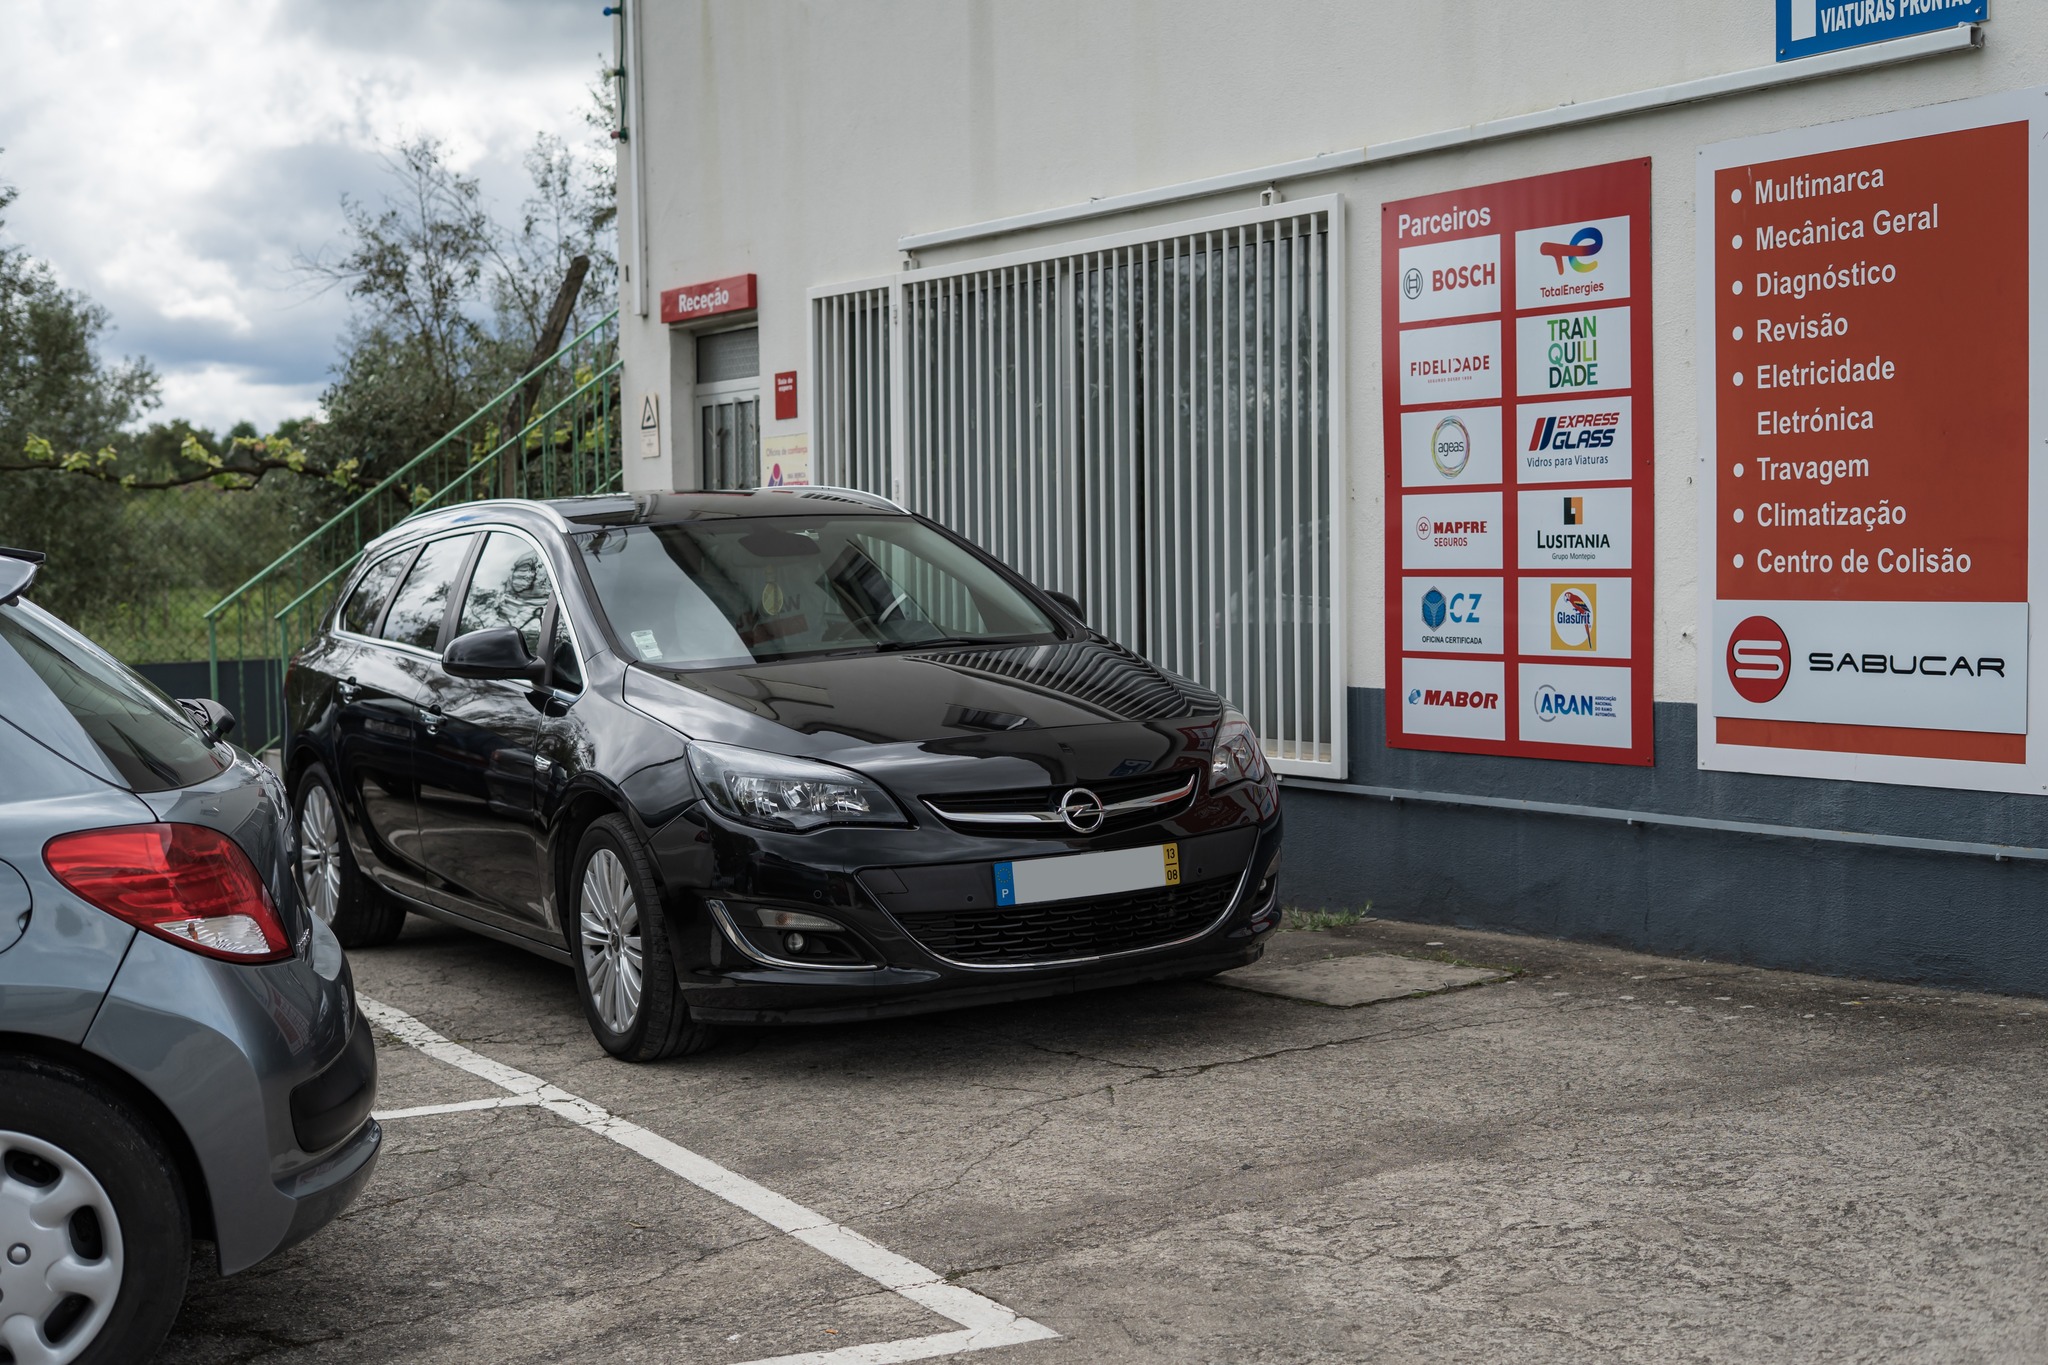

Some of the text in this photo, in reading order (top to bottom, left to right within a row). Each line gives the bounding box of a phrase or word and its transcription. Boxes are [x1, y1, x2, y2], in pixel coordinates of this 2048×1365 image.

[1820, 0, 1895, 34] VIATURAS
[1755, 167, 1884, 204] Multimarca
[1398, 206, 1491, 239] Parceiros
[1755, 203, 1938, 251] Mecânica Geral
[1432, 262, 1496, 292] BOSCH
[1540, 281, 1604, 298] TotalEnergies
[1756, 260, 1896, 300] Diagnóstico
[678, 287, 729, 313] Receção
[1547, 316, 1597, 341] TRAN
[1757, 312, 1848, 343] Revisão
[1410, 355, 1490, 376] FIDELIDADE
[1548, 340, 1597, 367] QUILI
[1549, 363, 1598, 388] DADE
[1757, 356, 1895, 389] Eletricidade
[1557, 412, 1620, 428] EXPRESS
[1757, 405, 1874, 435] Eletrónica
[1437, 440, 1464, 455] ageas
[1552, 428, 1616, 450] GLASS
[1526, 455, 1609, 468] Vidros para Viaturas
[1757, 456, 1869, 485] Travagem
[1433, 520, 1488, 534] MAPFRE
[1757, 500, 1906, 532] Climatização
[1434, 537, 1468, 547] SEGUROS
[1537, 530, 1611, 549] LUSITANIA
[1552, 552, 1596, 561] Grupo Montepio
[1756, 546, 1972, 574] Centro de Colisão
[1450, 592, 1482, 623] CZ
[1557, 611, 1591, 625] Glasurit
[1421, 635, 1483, 645] OFICINA CERTIFICADA
[1808, 651, 2006, 678] SABUCAR
[1424, 689, 1499, 710] MABOR
[1540, 693, 1593, 716] ARAN
[1166, 848, 1175, 859] 13
[1167, 870, 1178, 881] 08
[1001, 888, 1009, 898] P
